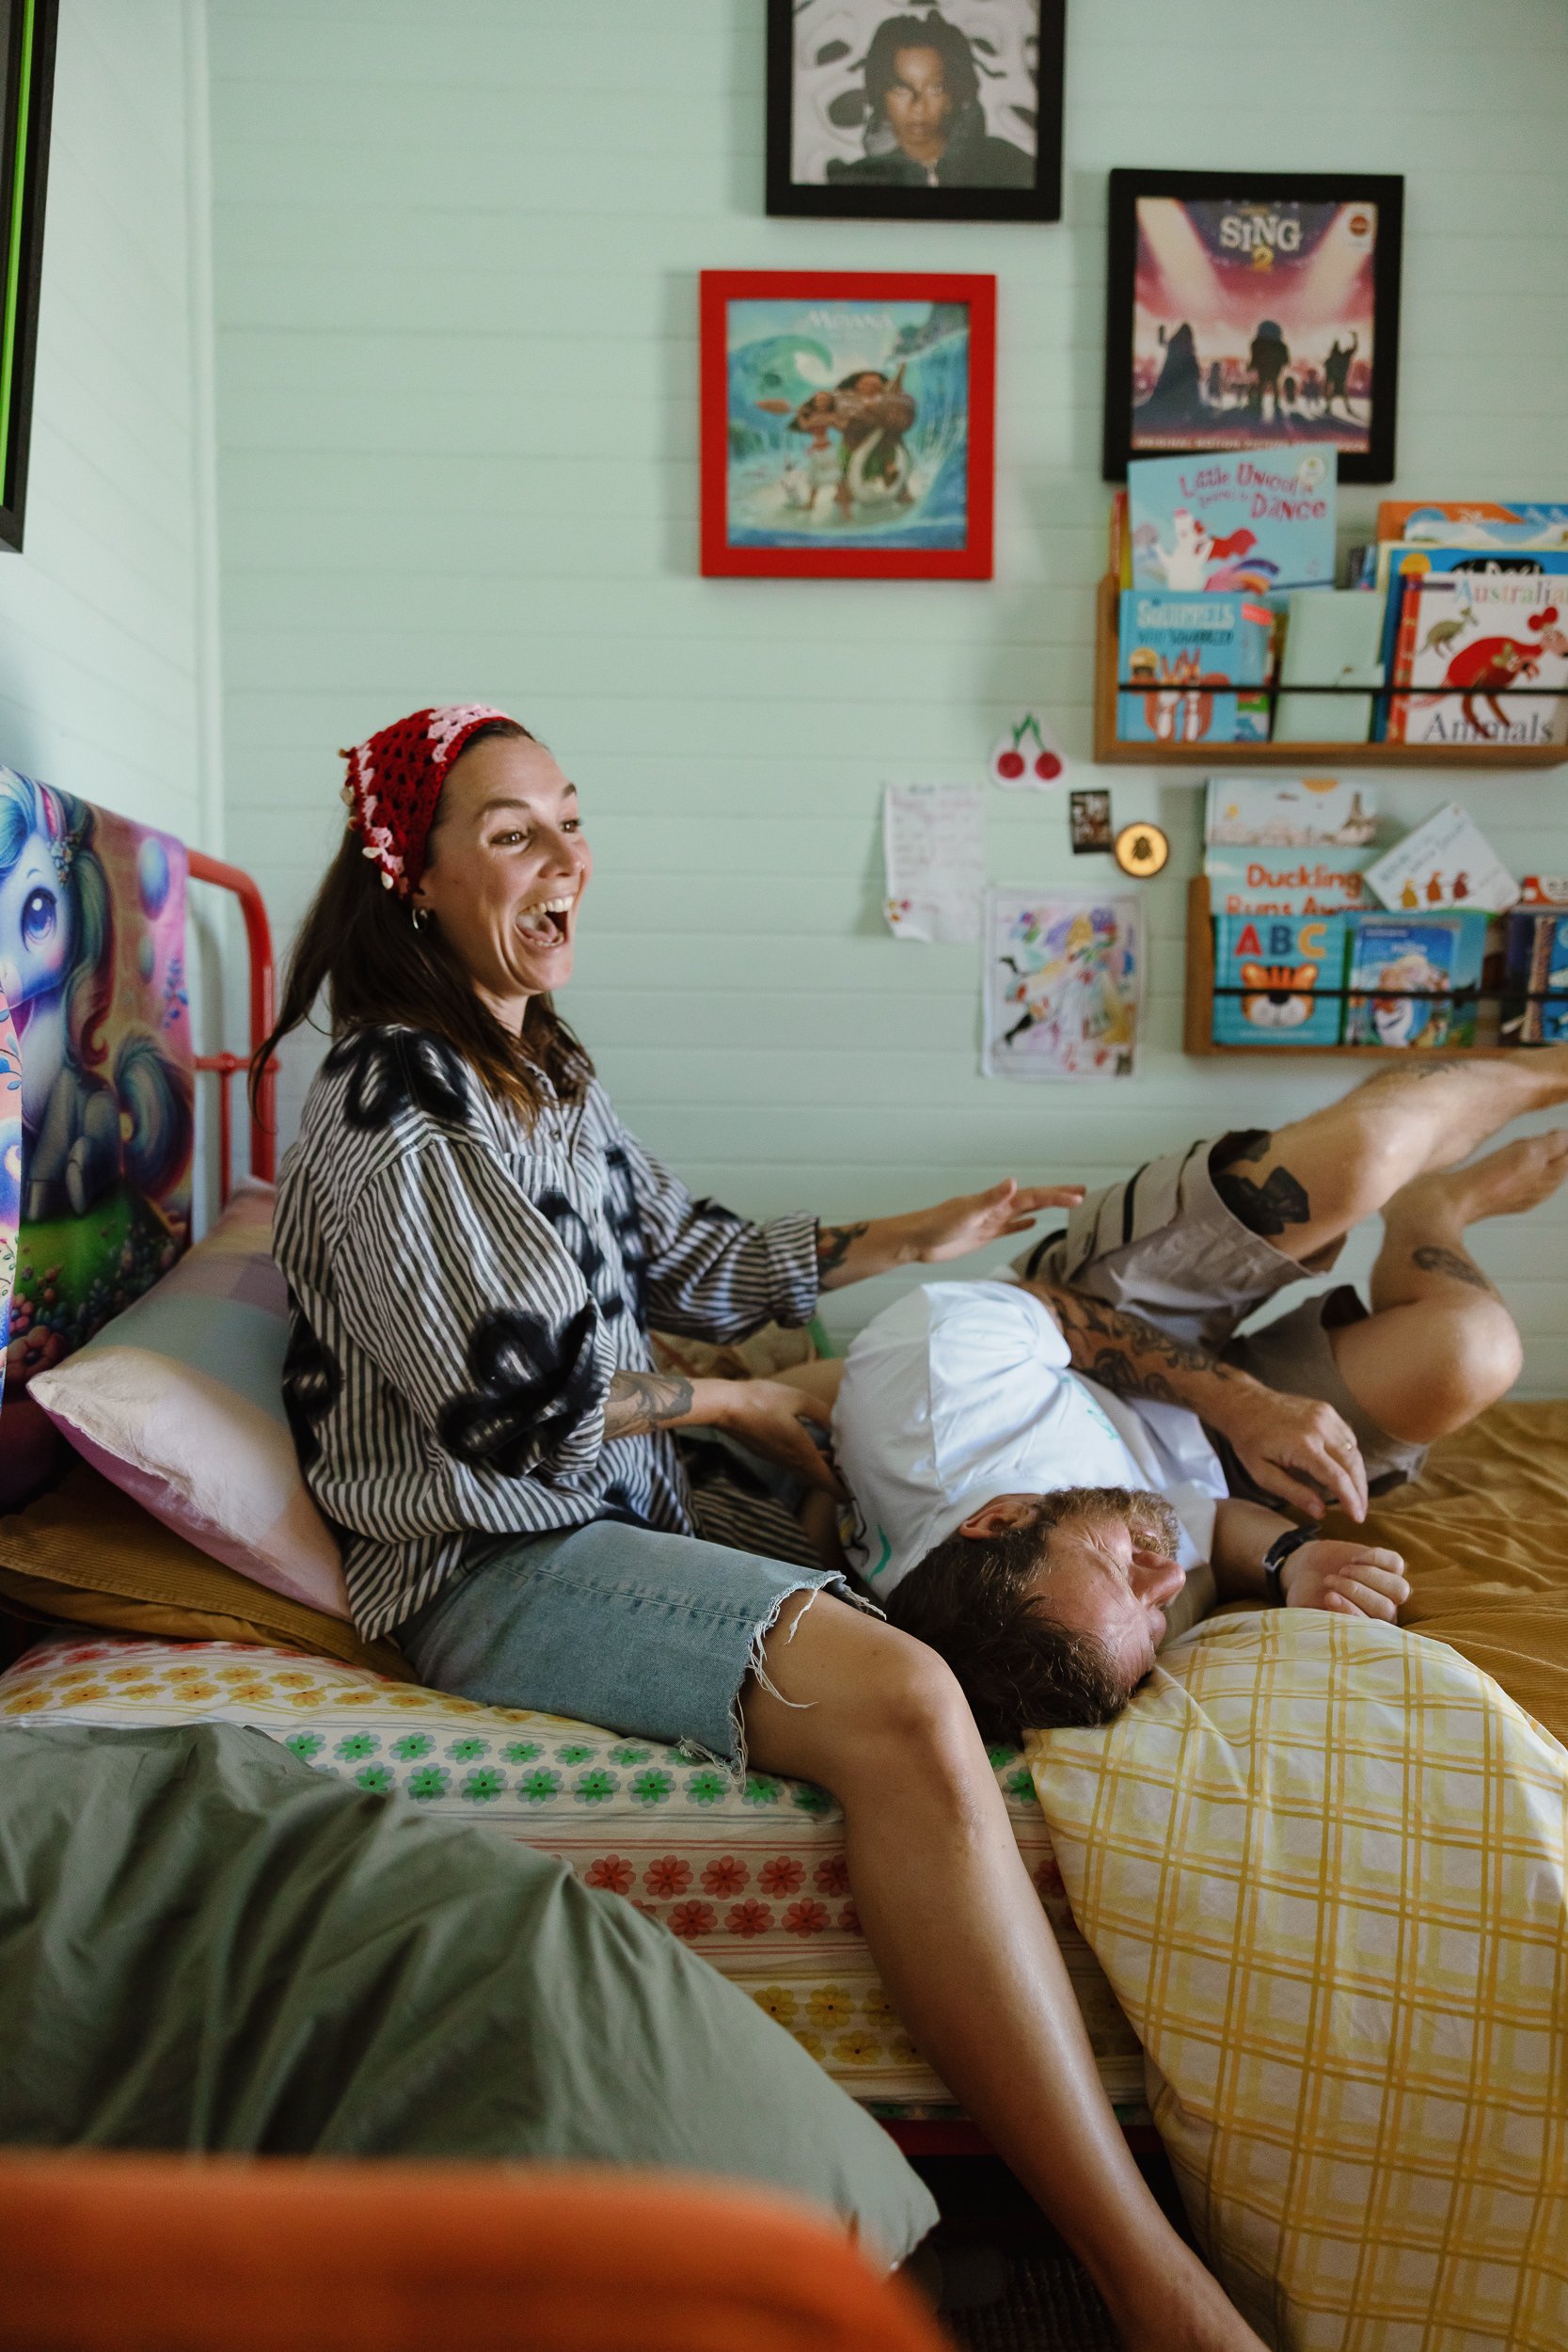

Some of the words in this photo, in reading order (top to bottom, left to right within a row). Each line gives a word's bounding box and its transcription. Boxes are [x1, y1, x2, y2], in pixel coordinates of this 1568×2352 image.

[1251, 246, 1275, 272] 2
[1453, 578, 1568, 605] Australia
[1246, 863, 1363, 899] Duckling
[1234, 922, 1327, 959] ABC
